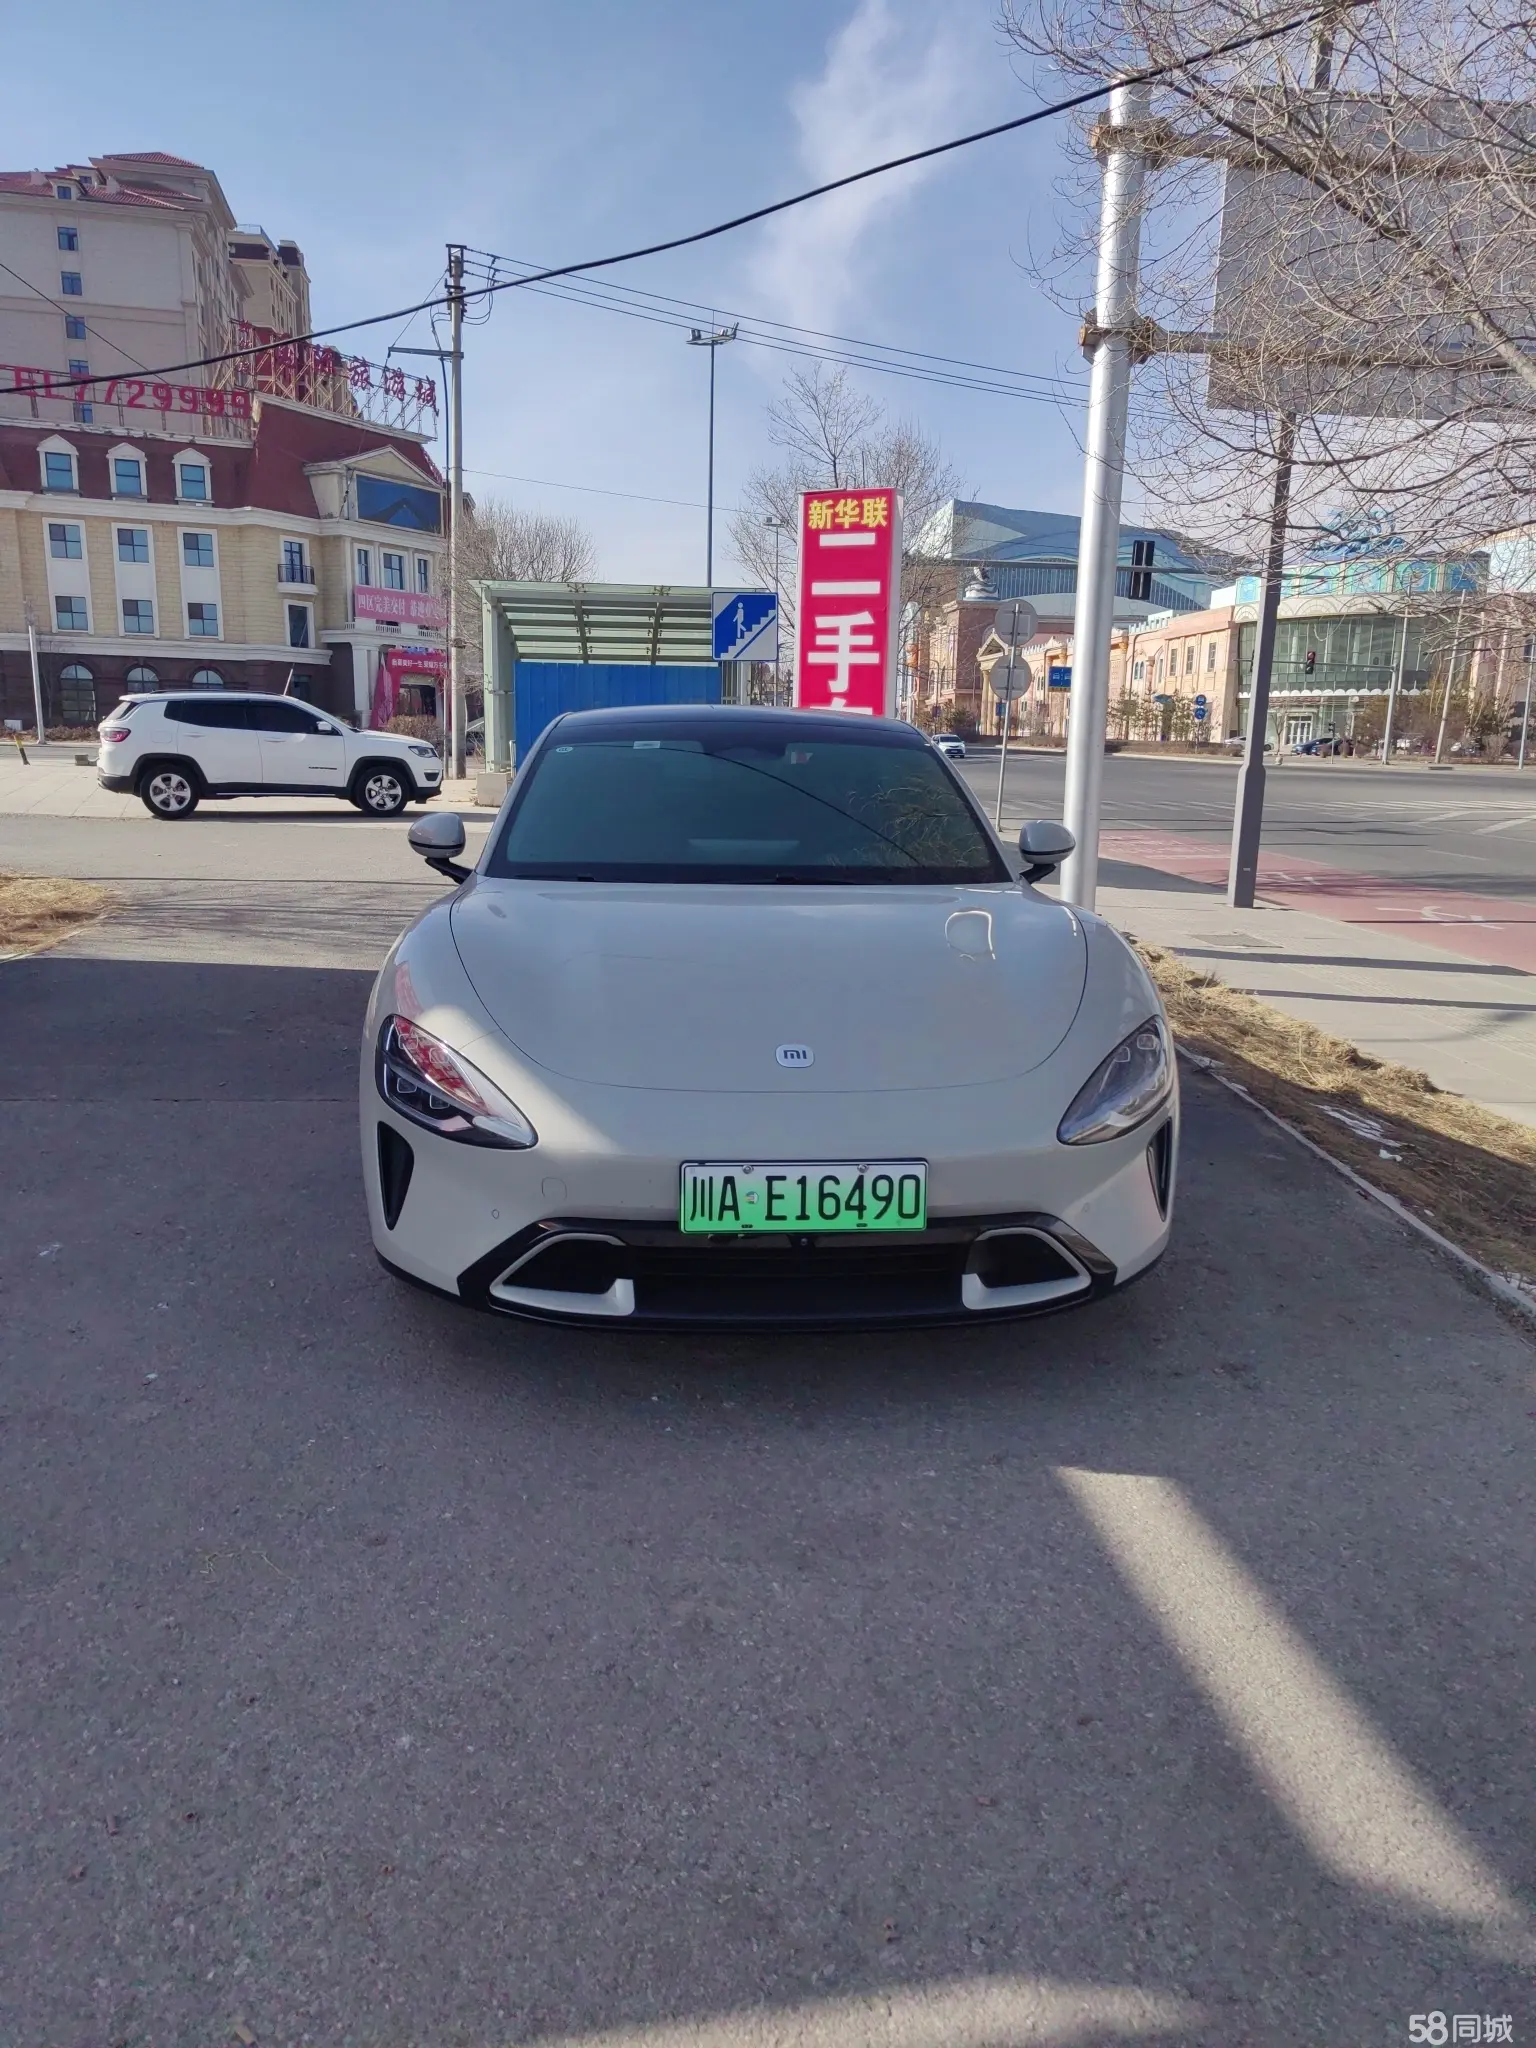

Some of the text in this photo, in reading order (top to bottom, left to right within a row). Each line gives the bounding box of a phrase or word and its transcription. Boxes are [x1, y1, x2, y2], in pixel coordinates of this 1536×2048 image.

[0, 364, 250, 419] EL7729999
[808, 496, 888, 530] 新华联
[690, 1174, 921, 1221] 川A E16490
